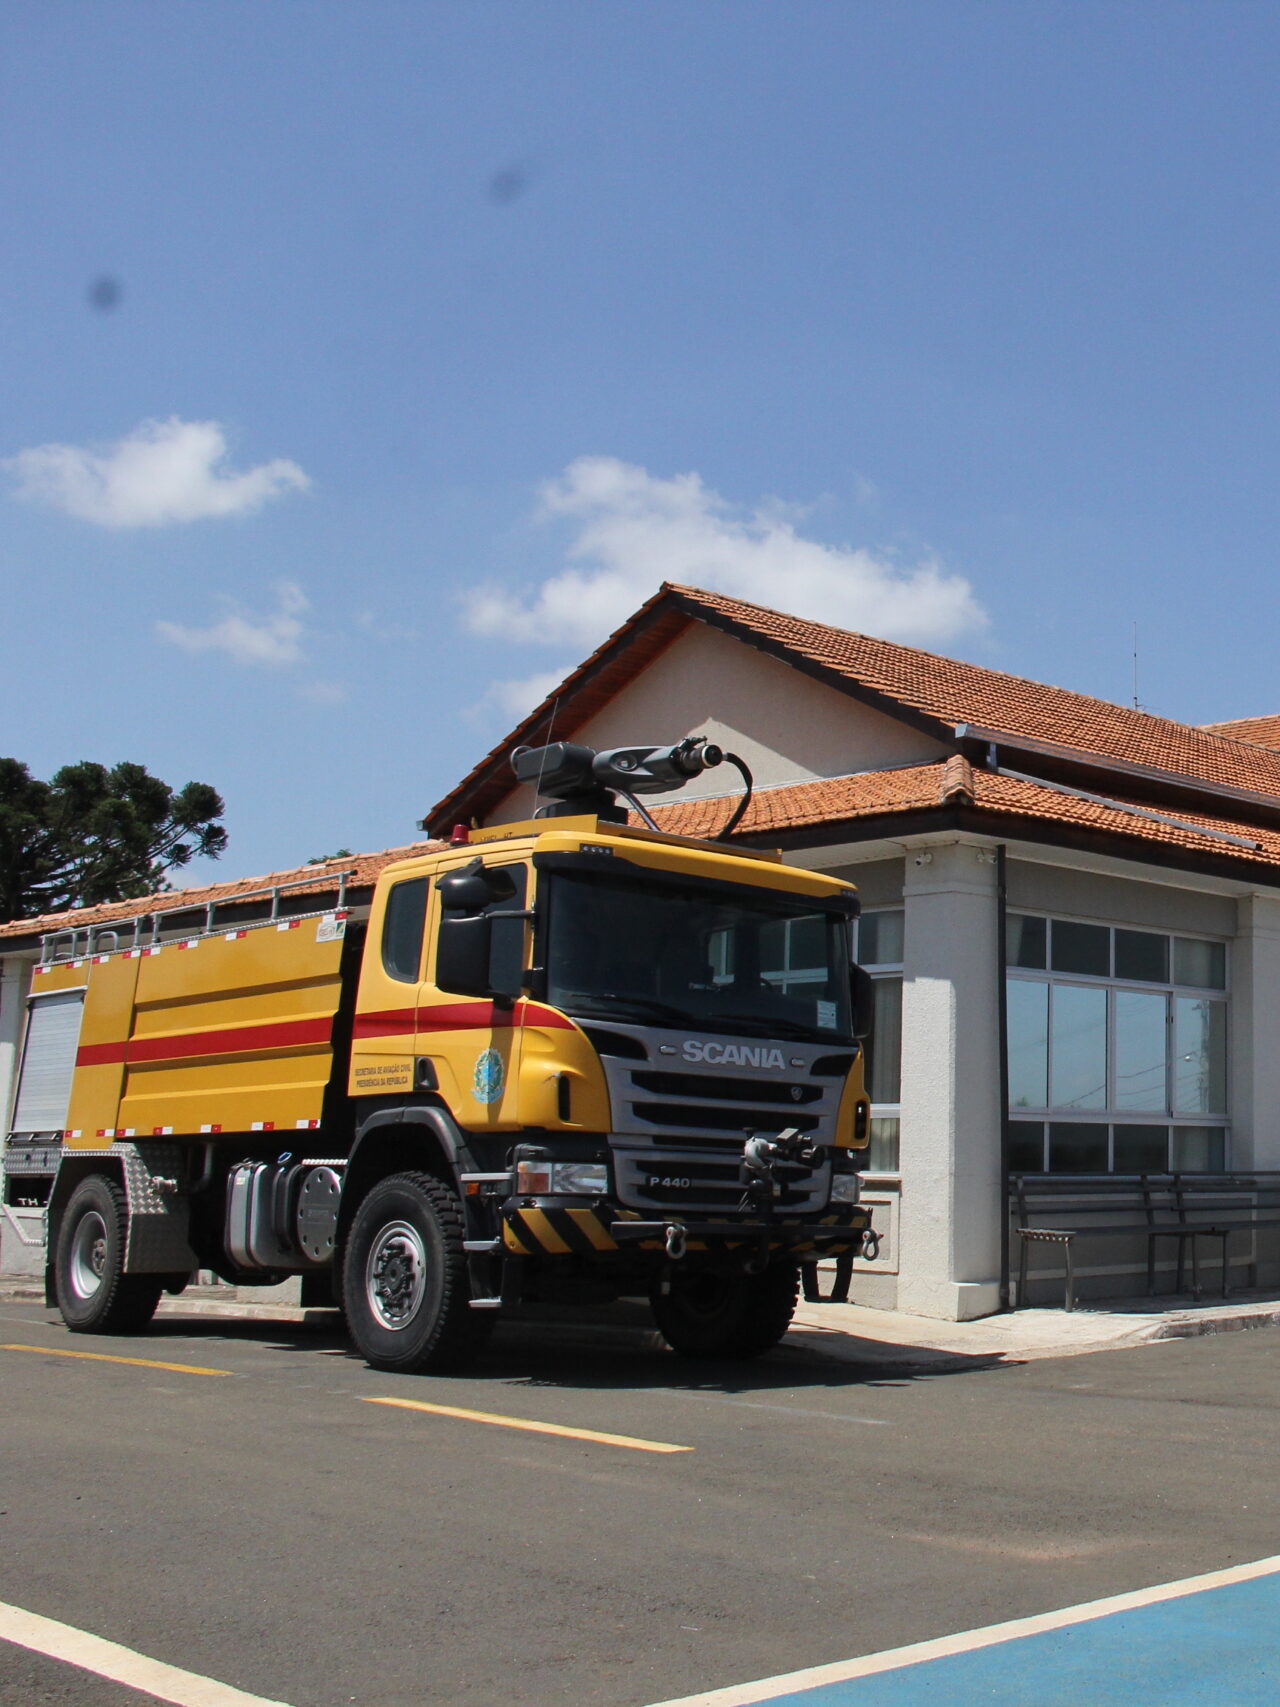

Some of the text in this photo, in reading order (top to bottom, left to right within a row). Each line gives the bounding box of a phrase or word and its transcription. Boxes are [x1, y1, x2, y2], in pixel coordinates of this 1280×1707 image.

[682, 1040, 786, 1070] SCANIA
[401, 1064, 410, 1072] CIVIL
[650, 1176, 690, 1188] P 440
